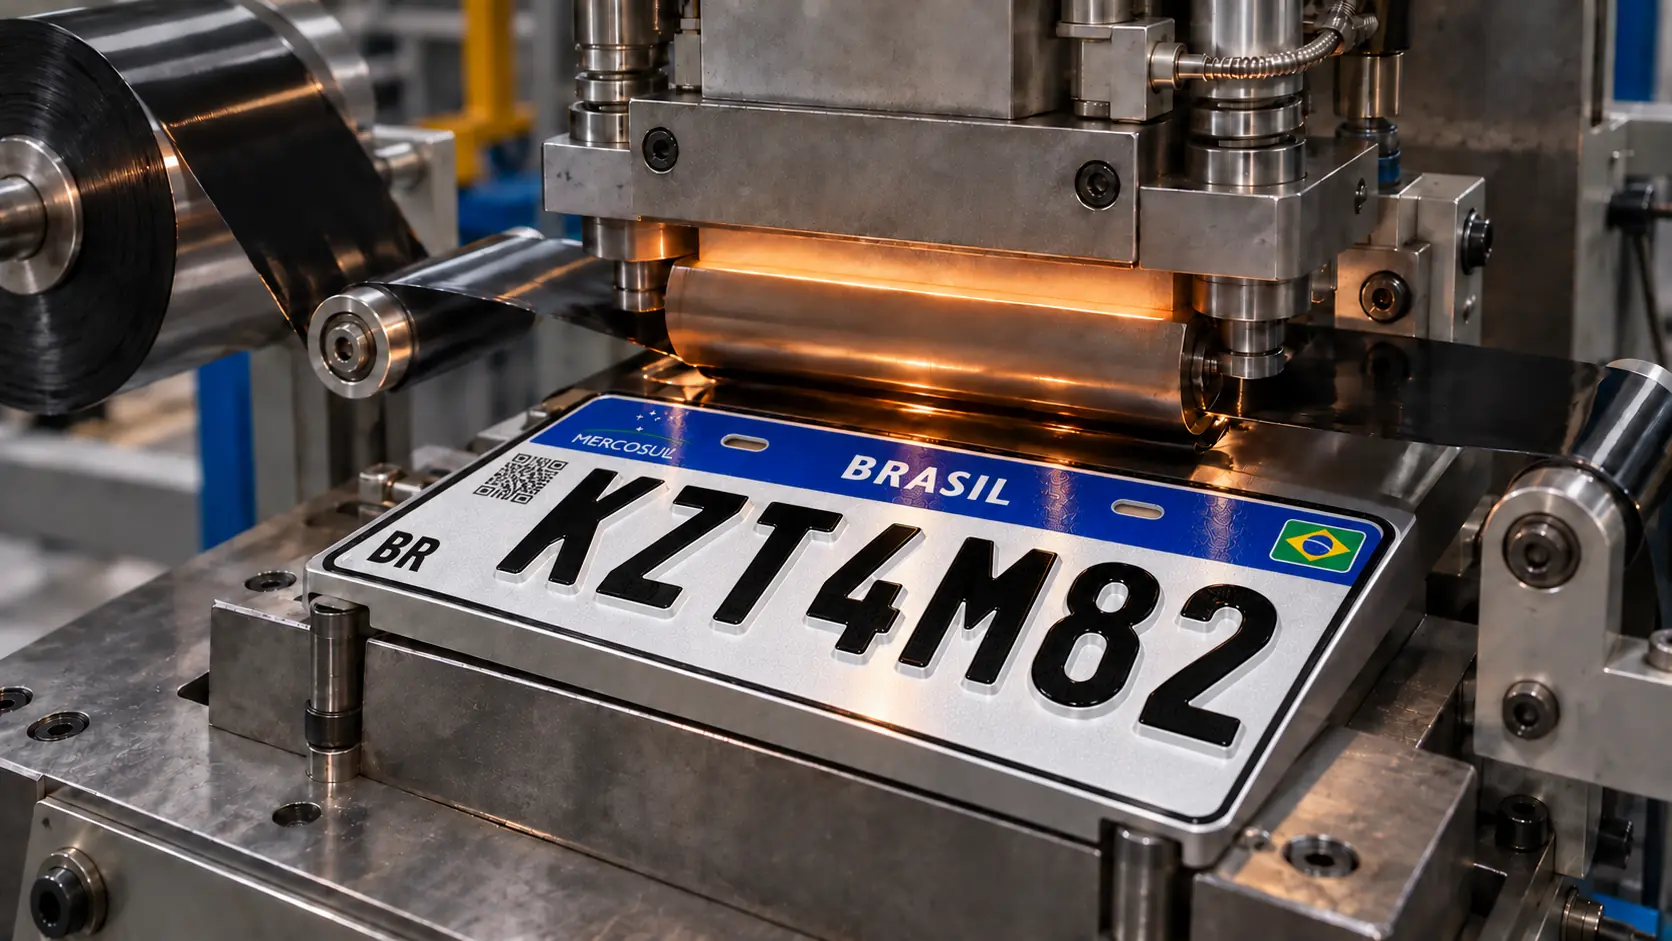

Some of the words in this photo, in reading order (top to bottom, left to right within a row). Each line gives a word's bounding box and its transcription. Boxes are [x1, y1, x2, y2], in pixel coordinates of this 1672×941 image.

[571, 433, 676, 459] MERCOSUL
[841, 454, 1010, 506] BRASIL
[366, 530, 440, 572] BR
[495, 468, 1277, 748] KZT4M82
